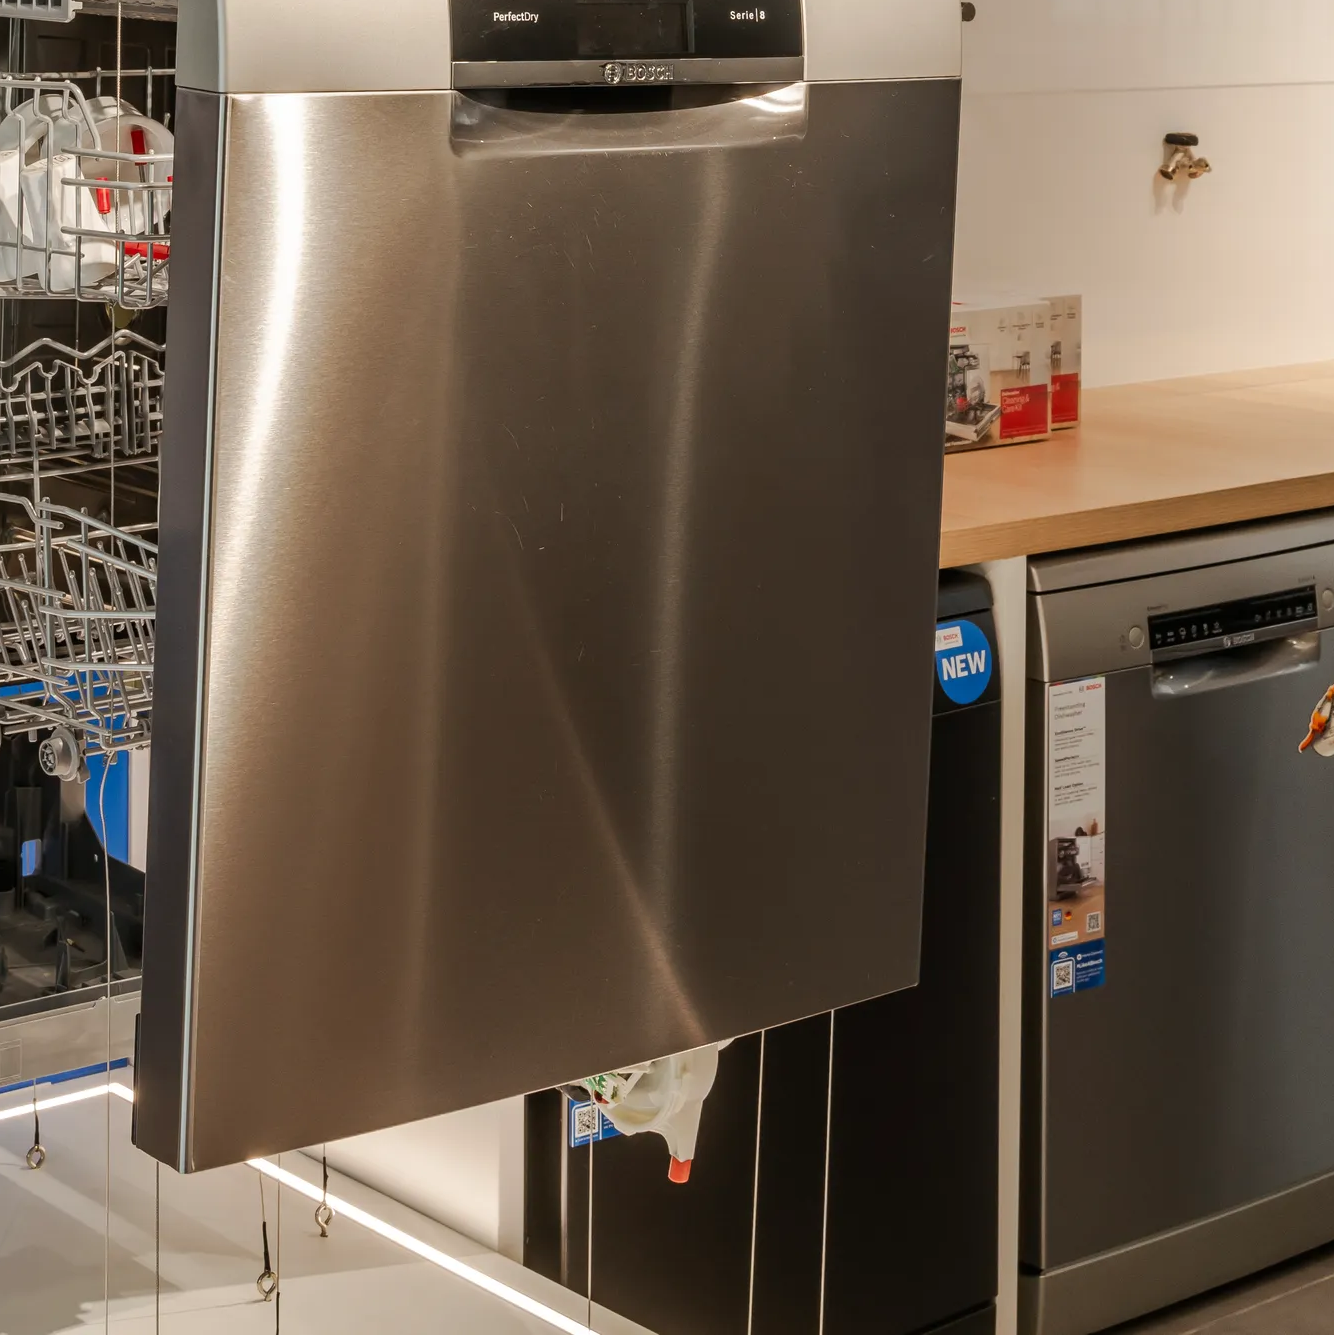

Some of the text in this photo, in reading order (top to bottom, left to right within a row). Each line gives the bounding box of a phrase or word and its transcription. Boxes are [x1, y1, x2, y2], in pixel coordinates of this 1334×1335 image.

[493, 11, 539, 23] PerfectDry
[626, 64, 675, 81] BOSCH
[941, 649, 986, 681] NEW
